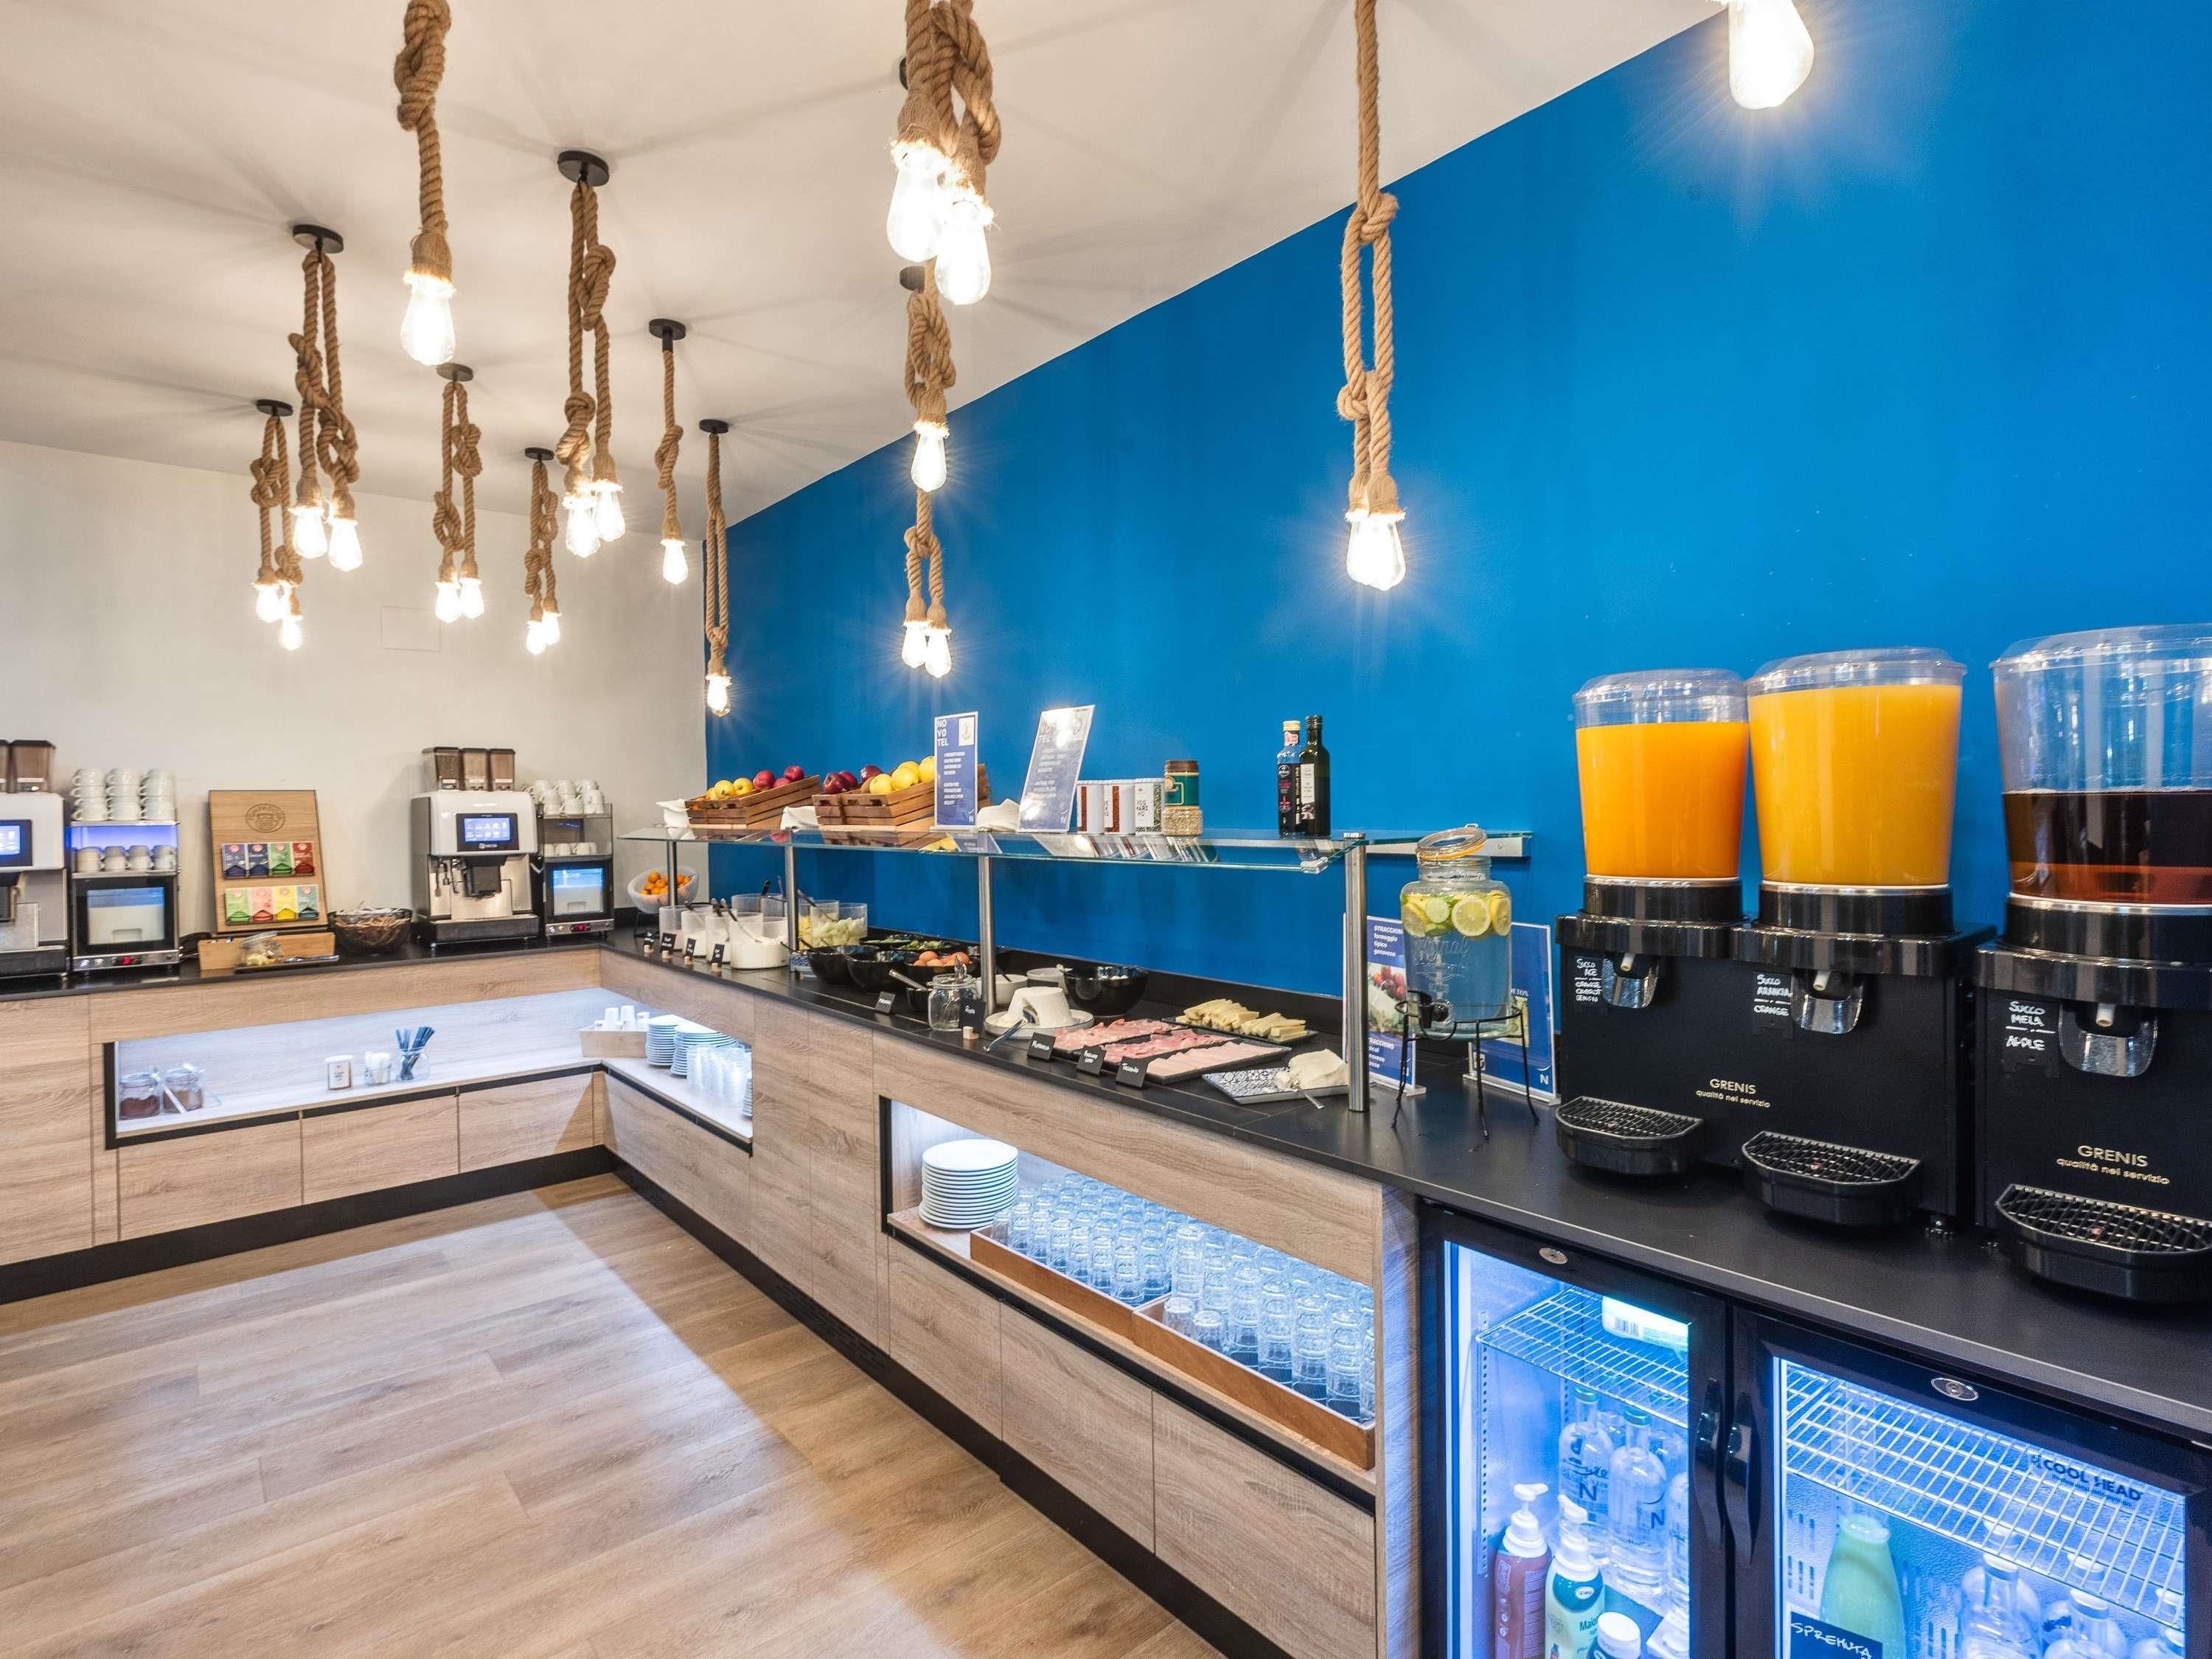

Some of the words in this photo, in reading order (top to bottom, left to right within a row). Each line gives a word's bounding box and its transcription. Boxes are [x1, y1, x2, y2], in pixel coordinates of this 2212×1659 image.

[937, 728, 947, 737] VO
[937, 738, 949, 747] TEL
[2011, 1013, 2045, 1026] MELA
[2006, 1035, 2045, 1050] APPLE
[1539, 1074, 1549, 1085] N
[1709, 1078, 1757, 1094] GRENIS
[1739, 1097, 1771, 1108] servizio
[2077, 1145, 2149, 1168] GRENIS
[2056, 1158, 2099, 1172] qualità
[2123, 1170, 2171, 1185] servizio
[2043, 1459, 2090, 1484] COOL
[2094, 1475, 2144, 1501] HEAD
